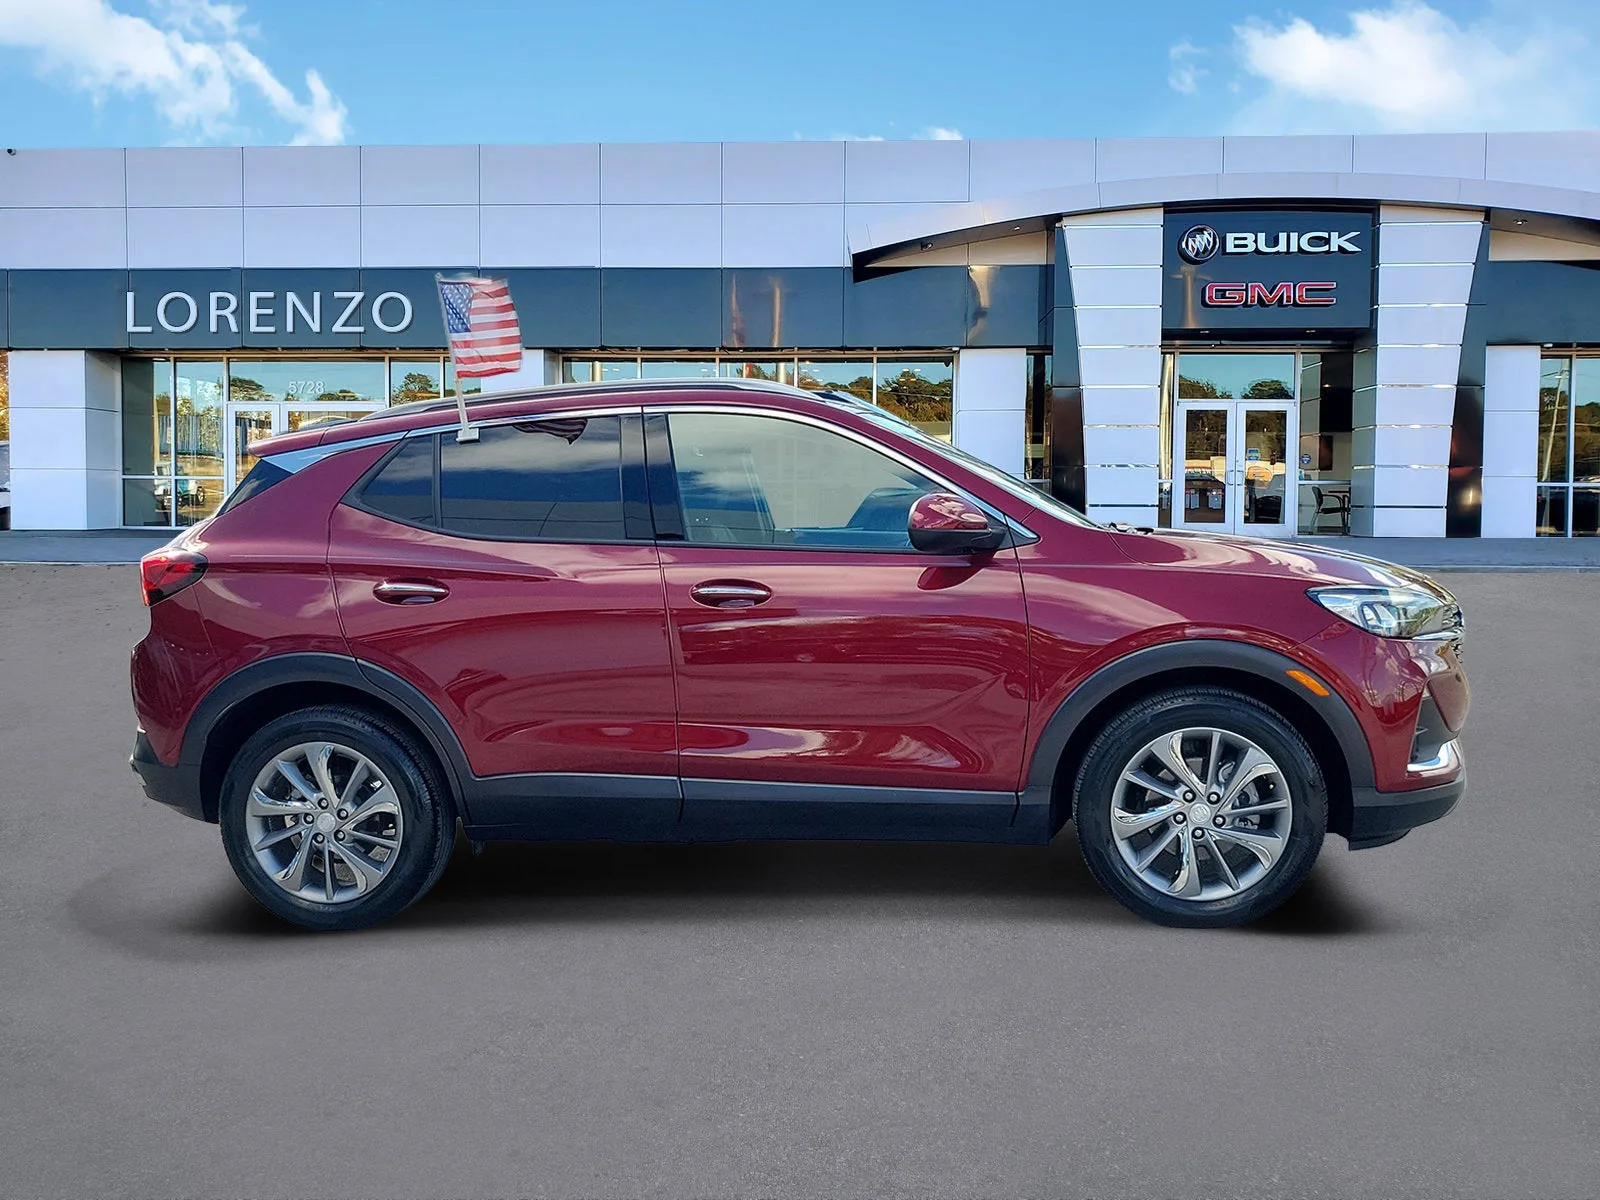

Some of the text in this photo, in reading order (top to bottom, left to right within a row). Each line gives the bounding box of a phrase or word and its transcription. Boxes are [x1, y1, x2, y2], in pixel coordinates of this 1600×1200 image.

[1225, 231, 1362, 253] BUICK
[1205, 281, 1337, 306] GMC
[126, 291, 414, 333] LORENZO
[288, 381, 325, 394] 5728
